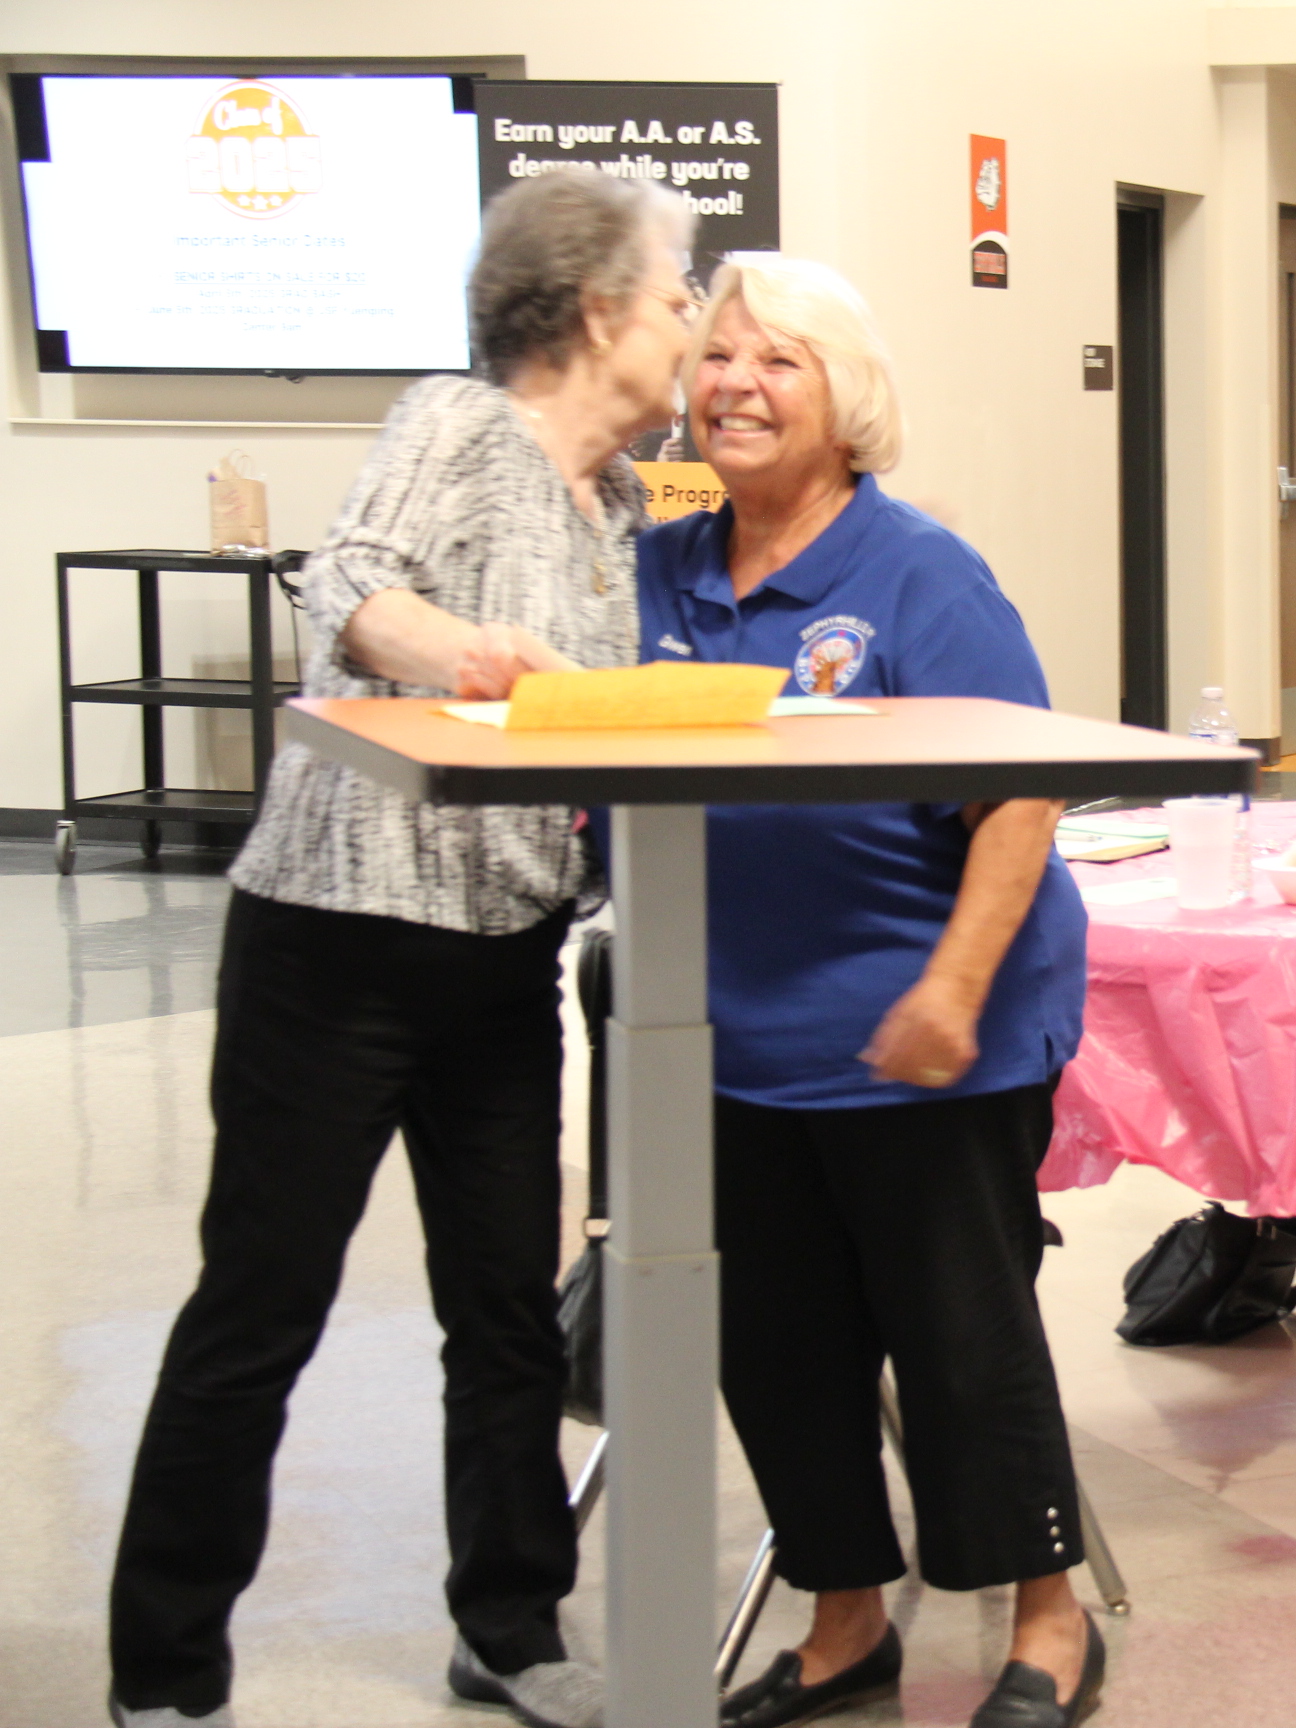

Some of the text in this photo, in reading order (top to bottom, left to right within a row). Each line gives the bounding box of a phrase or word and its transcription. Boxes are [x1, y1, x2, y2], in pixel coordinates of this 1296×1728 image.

[493, 118, 762, 150] Earn your A.A. or A.S.
[185, 135, 323, 194] 2025
[600, 154, 667, 180] while
[671, 159, 750, 186] you're
[683, 190, 744, 216] hool!
[174, 234, 347, 249] Important Senior Dates
